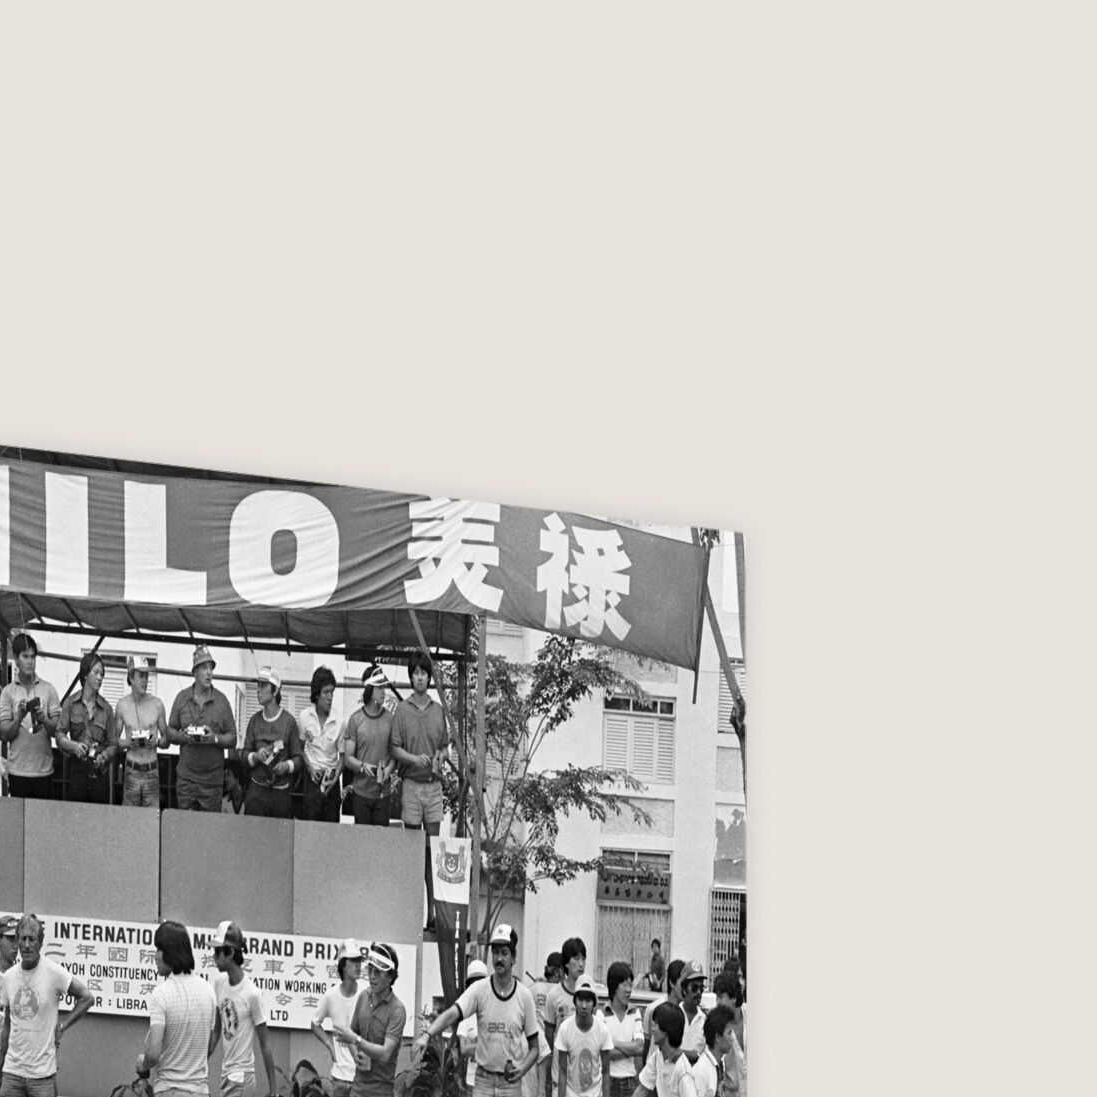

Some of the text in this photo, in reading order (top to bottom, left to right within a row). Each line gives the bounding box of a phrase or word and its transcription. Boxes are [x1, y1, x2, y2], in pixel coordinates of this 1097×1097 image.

[55, 922, 152, 945] INTERNATIO
[90, 964, 159, 981] CONSTITUENCY
[285, 980, 327, 995] WORKING
[116, 997, 148, 1011] LIBRA
[270, 1010, 288, 1021] LTD
